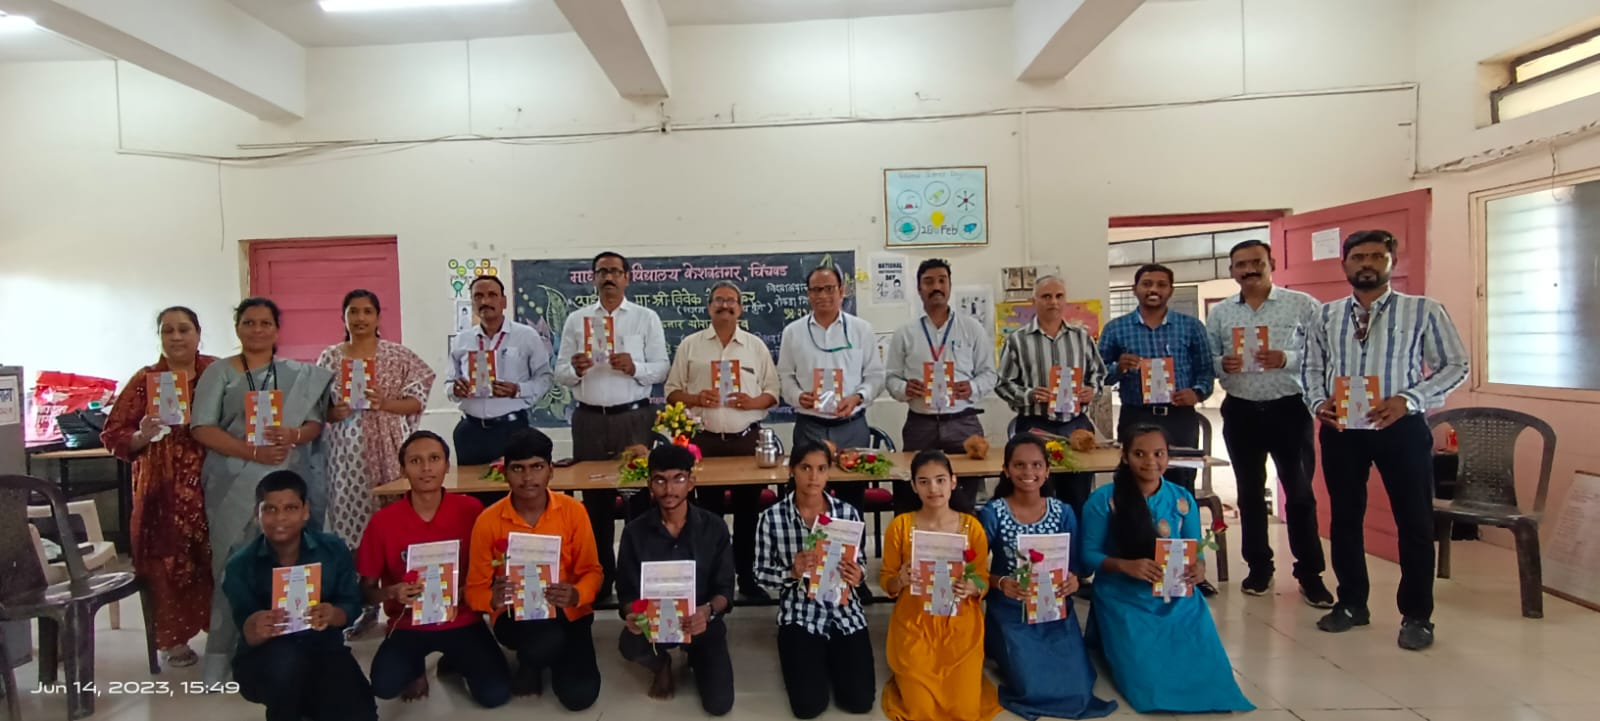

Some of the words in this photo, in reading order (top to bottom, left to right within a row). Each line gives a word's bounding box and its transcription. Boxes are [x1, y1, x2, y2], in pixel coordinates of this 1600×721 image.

[940, 224, 958, 235] Feb
[630, 262, 682, 282] विद्यालय
[748, 262, 788, 278] चिंचवड
